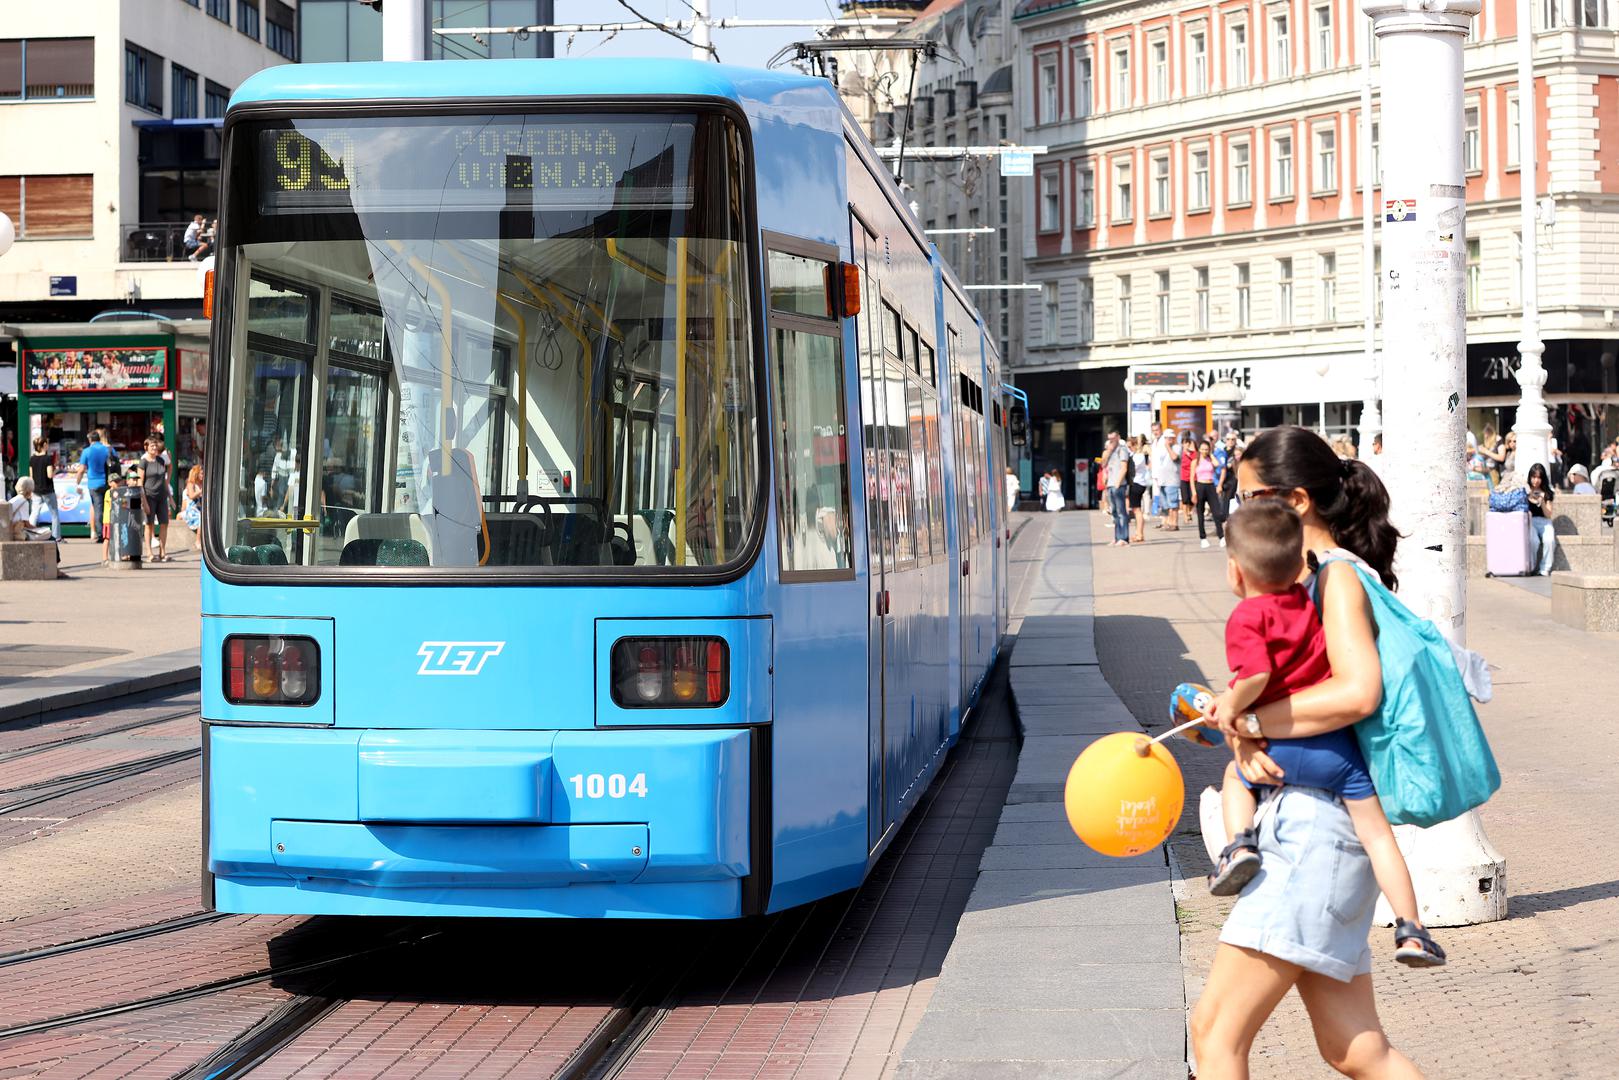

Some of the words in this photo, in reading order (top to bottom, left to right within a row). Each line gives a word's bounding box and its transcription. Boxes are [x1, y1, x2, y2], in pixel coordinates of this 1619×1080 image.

[455, 129, 617, 156] POSEBNA
[276, 132, 354, 190] 99
[1061, 393, 1100, 411] DOUGLAS
[416, 641, 507, 675] ZET
[569, 773, 648, 799] 1004
